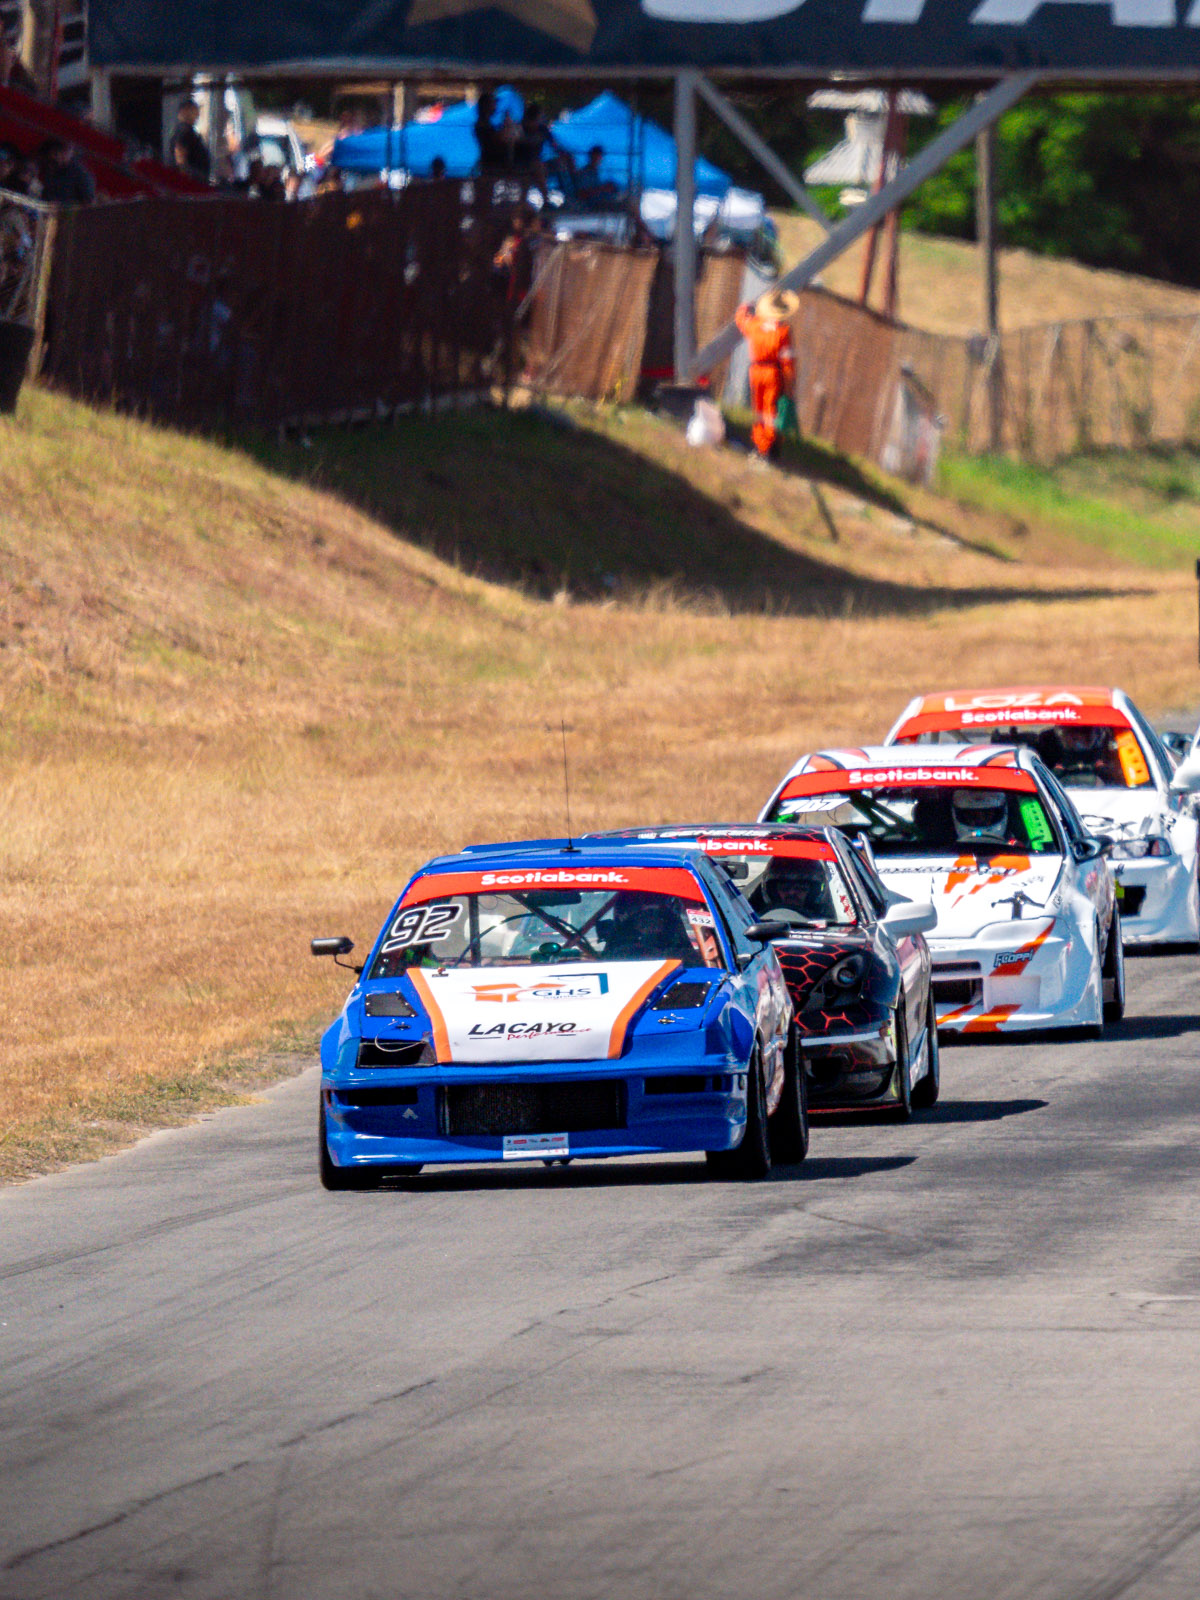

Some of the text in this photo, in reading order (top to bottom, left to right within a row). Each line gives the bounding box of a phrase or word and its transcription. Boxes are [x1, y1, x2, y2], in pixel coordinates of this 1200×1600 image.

[944, 693, 1083, 712] LOZA
[961, 708, 1081, 723] Scotiabank.
[849, 769, 979, 783] Scotiabank.
[481, 871, 629, 885] Scotiabank.
[381, 903, 463, 953] 92
[532, 988, 592, 997] GHS
[468, 1022, 577, 1035] LACAYO
